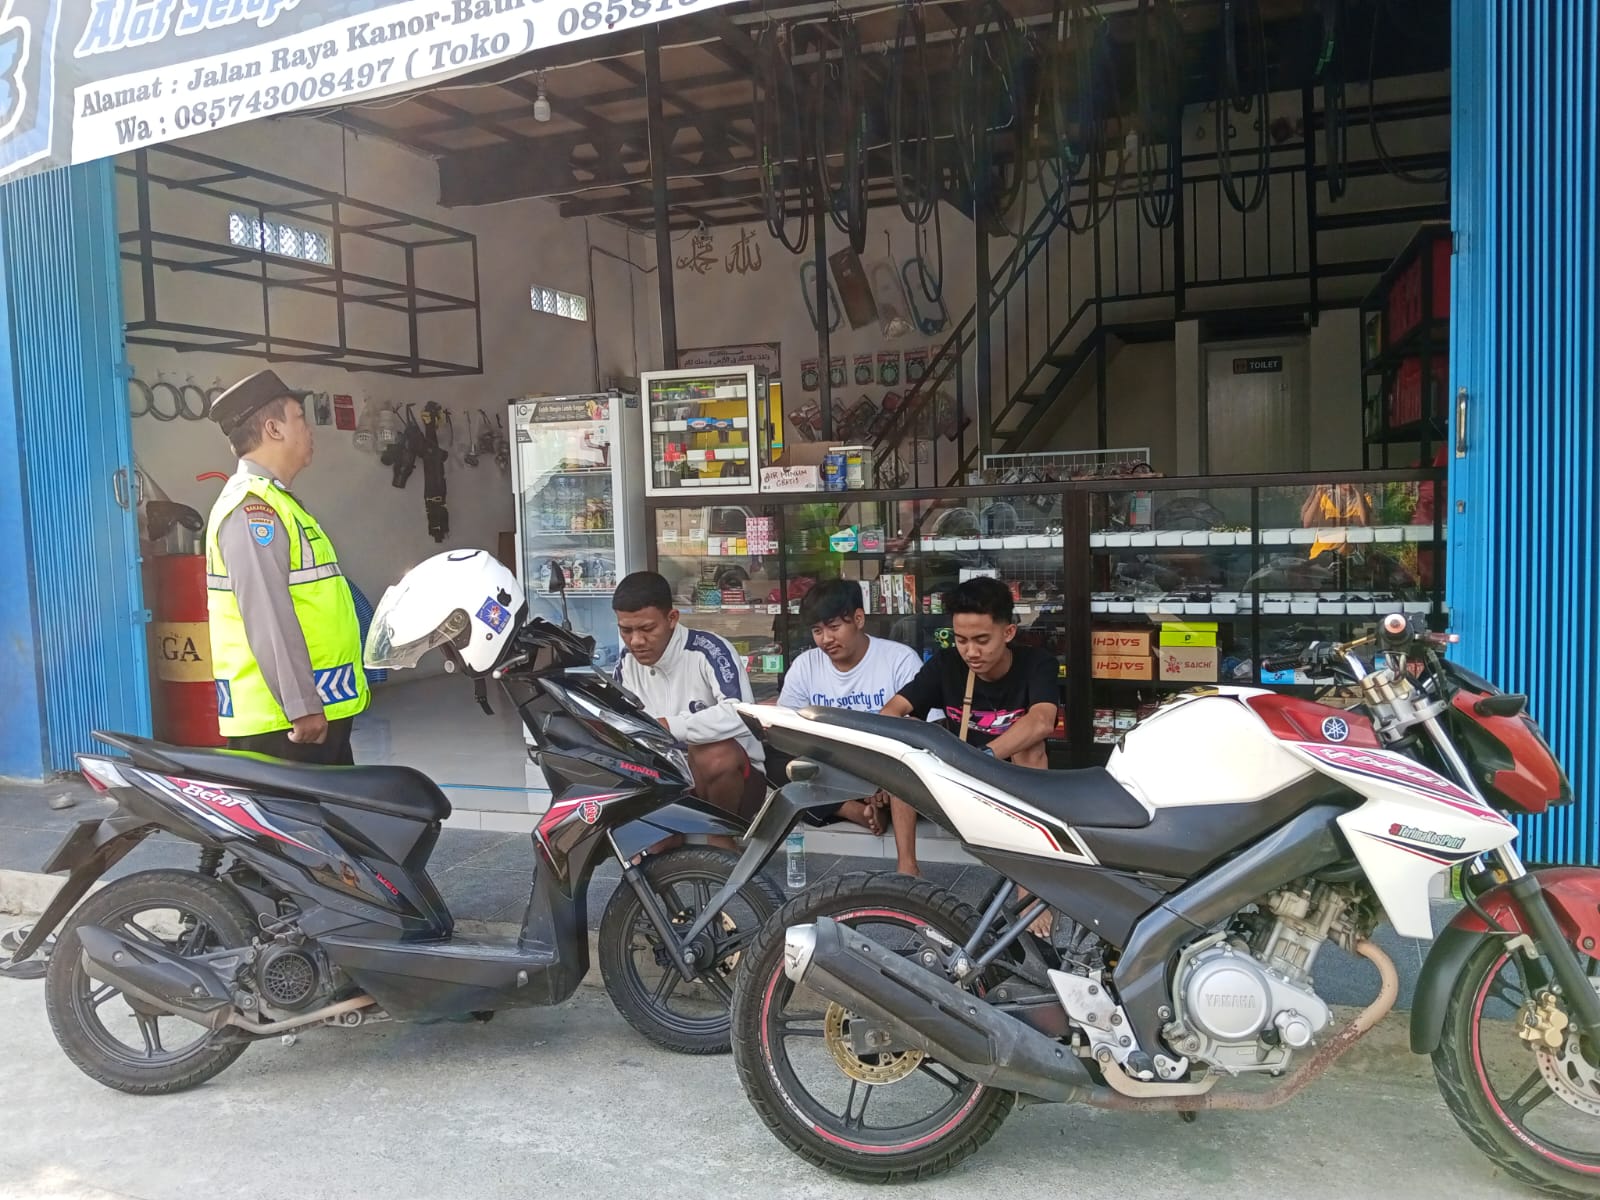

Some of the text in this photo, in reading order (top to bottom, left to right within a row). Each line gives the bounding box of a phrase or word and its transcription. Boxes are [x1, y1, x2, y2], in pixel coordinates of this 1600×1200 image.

[81, 76, 162, 118] Alamat
[187, 57, 262, 91] Jalan
[271, 38, 337, 73] Raya
[346, 0, 545, 52] Kanor-Bau
[115, 117, 151, 145] Wa
[174, 57, 395, 130] 085743008497
[430, 32, 511, 71] Toko
[558, 0, 698, 36] 0858
[1250, 360, 1279, 369] TOILET
[158, 636, 203, 662] GA
[1093, 638, 1141, 647] SAICHI
[1096, 661, 1145, 671] SAICHI
[1184, 661, 1212, 669] SAICHI
[836, 691, 872, 710] society
[873, 688, 885, 707] of
[620, 760, 660, 778] HONDA
[1205, 993, 1256, 1008] YAMAHA
